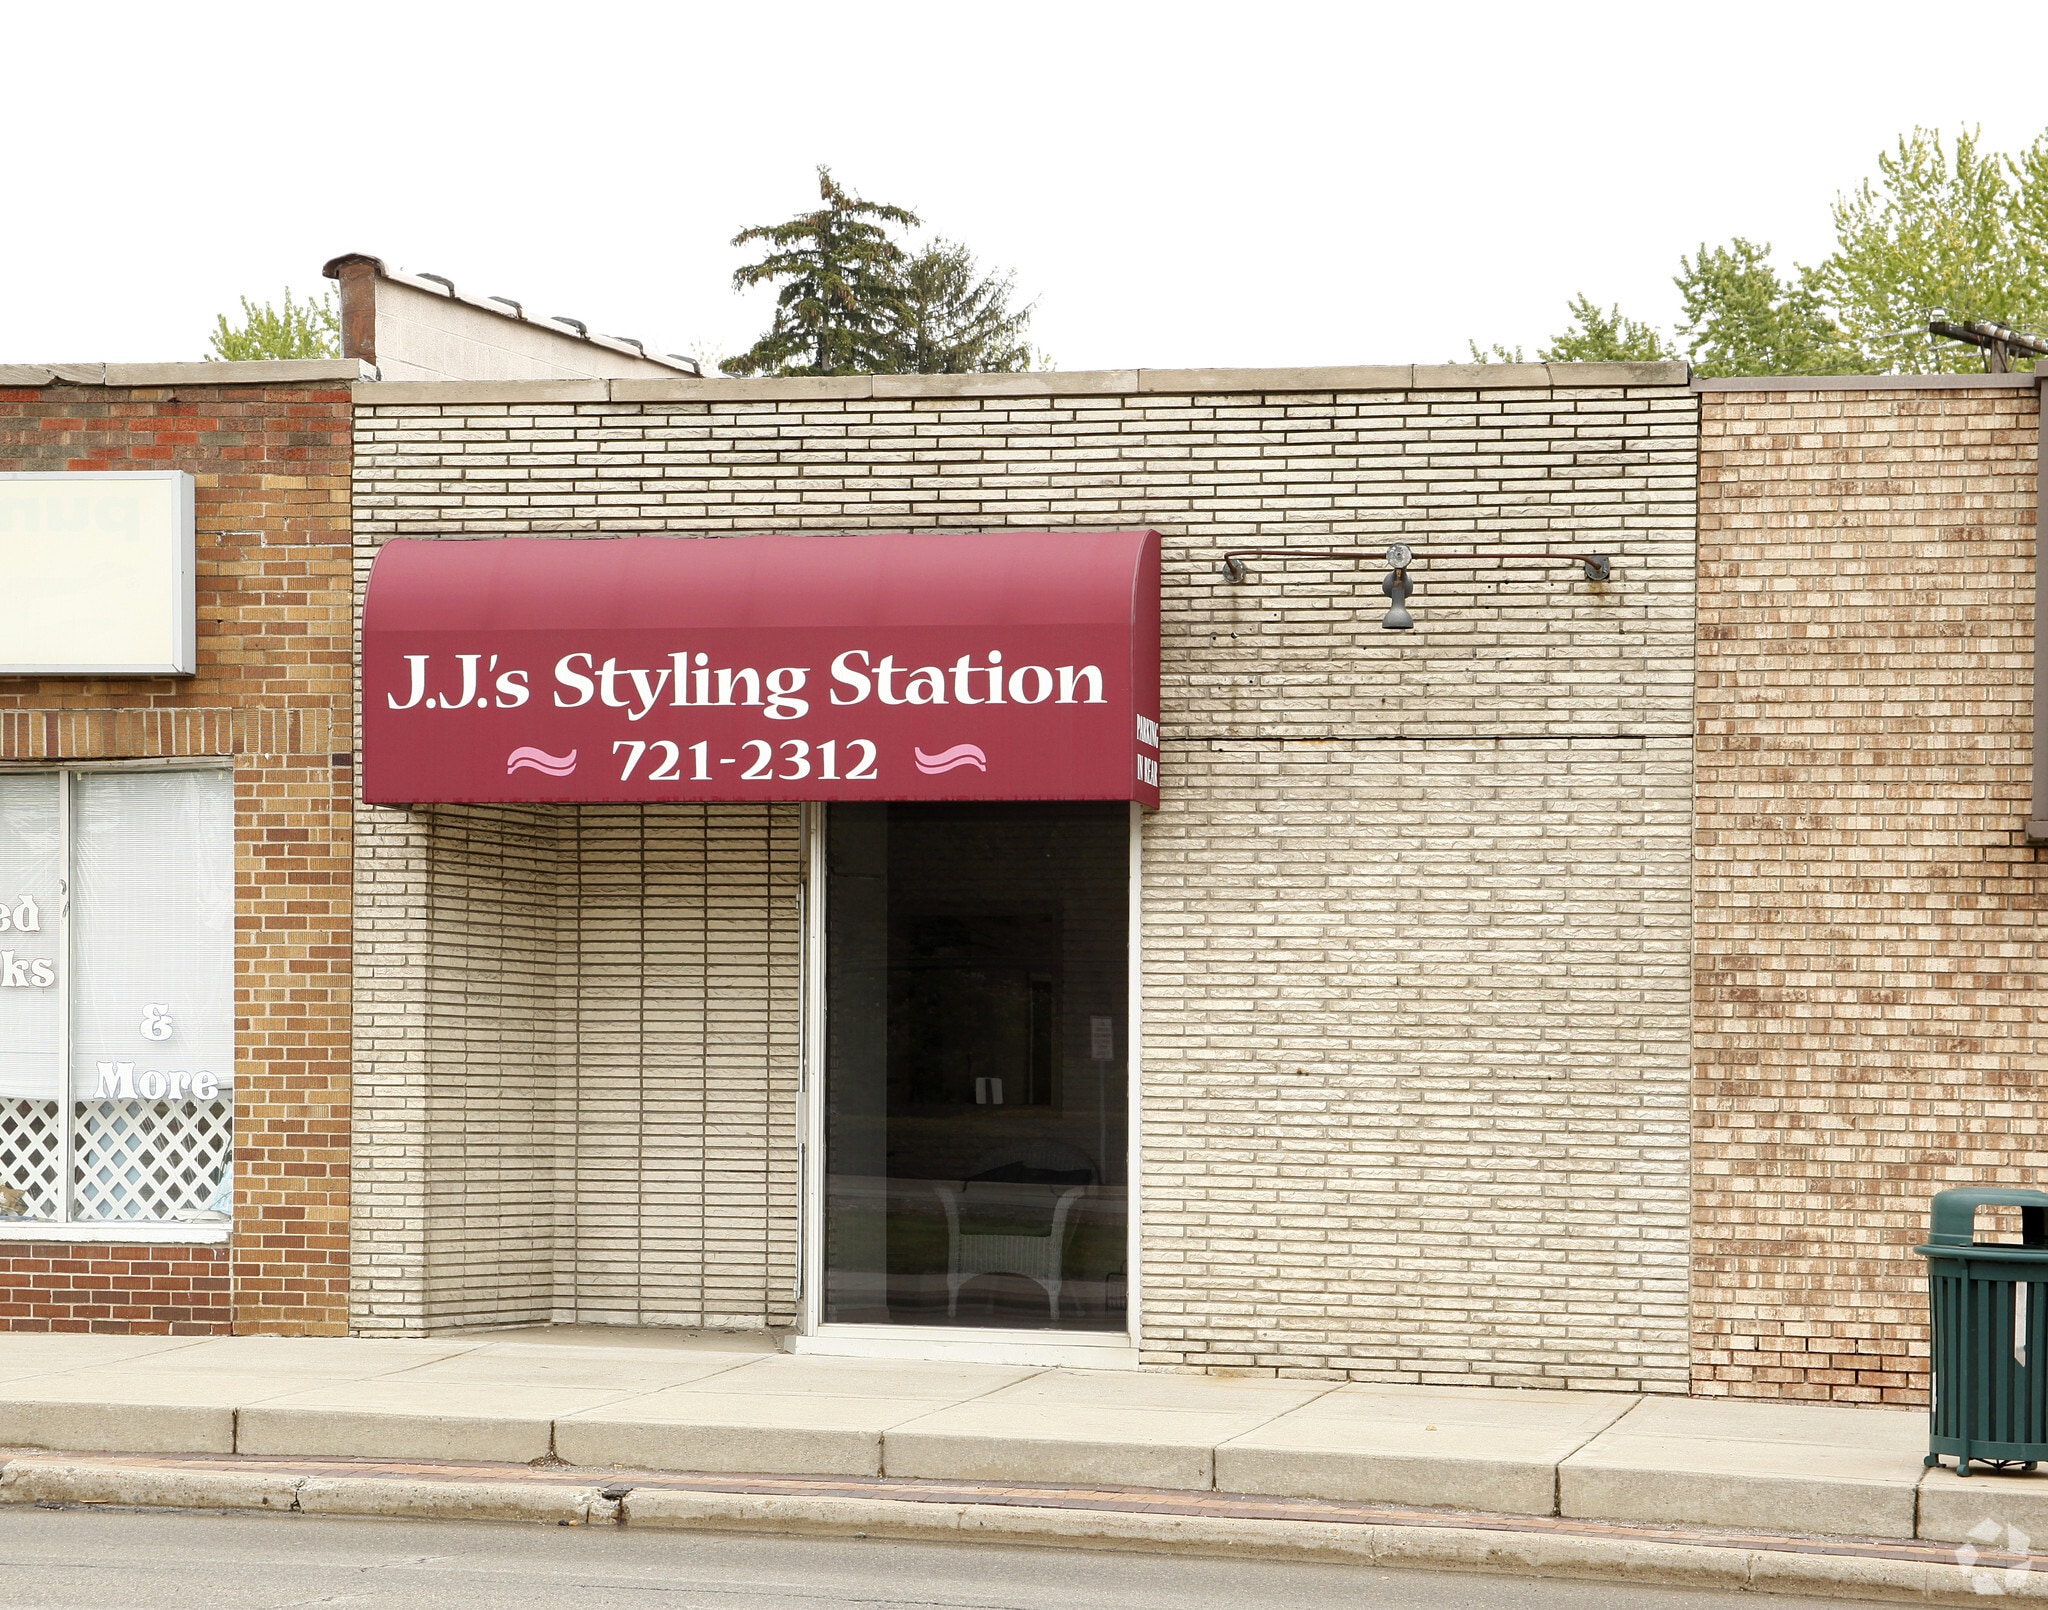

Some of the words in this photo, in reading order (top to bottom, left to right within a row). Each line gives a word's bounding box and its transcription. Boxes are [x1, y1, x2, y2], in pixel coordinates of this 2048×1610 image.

[387, 653, 530, 709] J.J.'s
[553, 651, 811, 722] Styling
[829, 649, 1108, 706] Station
[1137, 714, 1158, 748] PARKING
[612, 739, 878, 782] 721-2312
[1138, 754, 1143, 781] IN
[1144, 757, 1158, 787] REAR
[0, 949, 56, 988] ks
[139, 1003, 174, 1041] &
[93, 1060, 219, 1100] More
